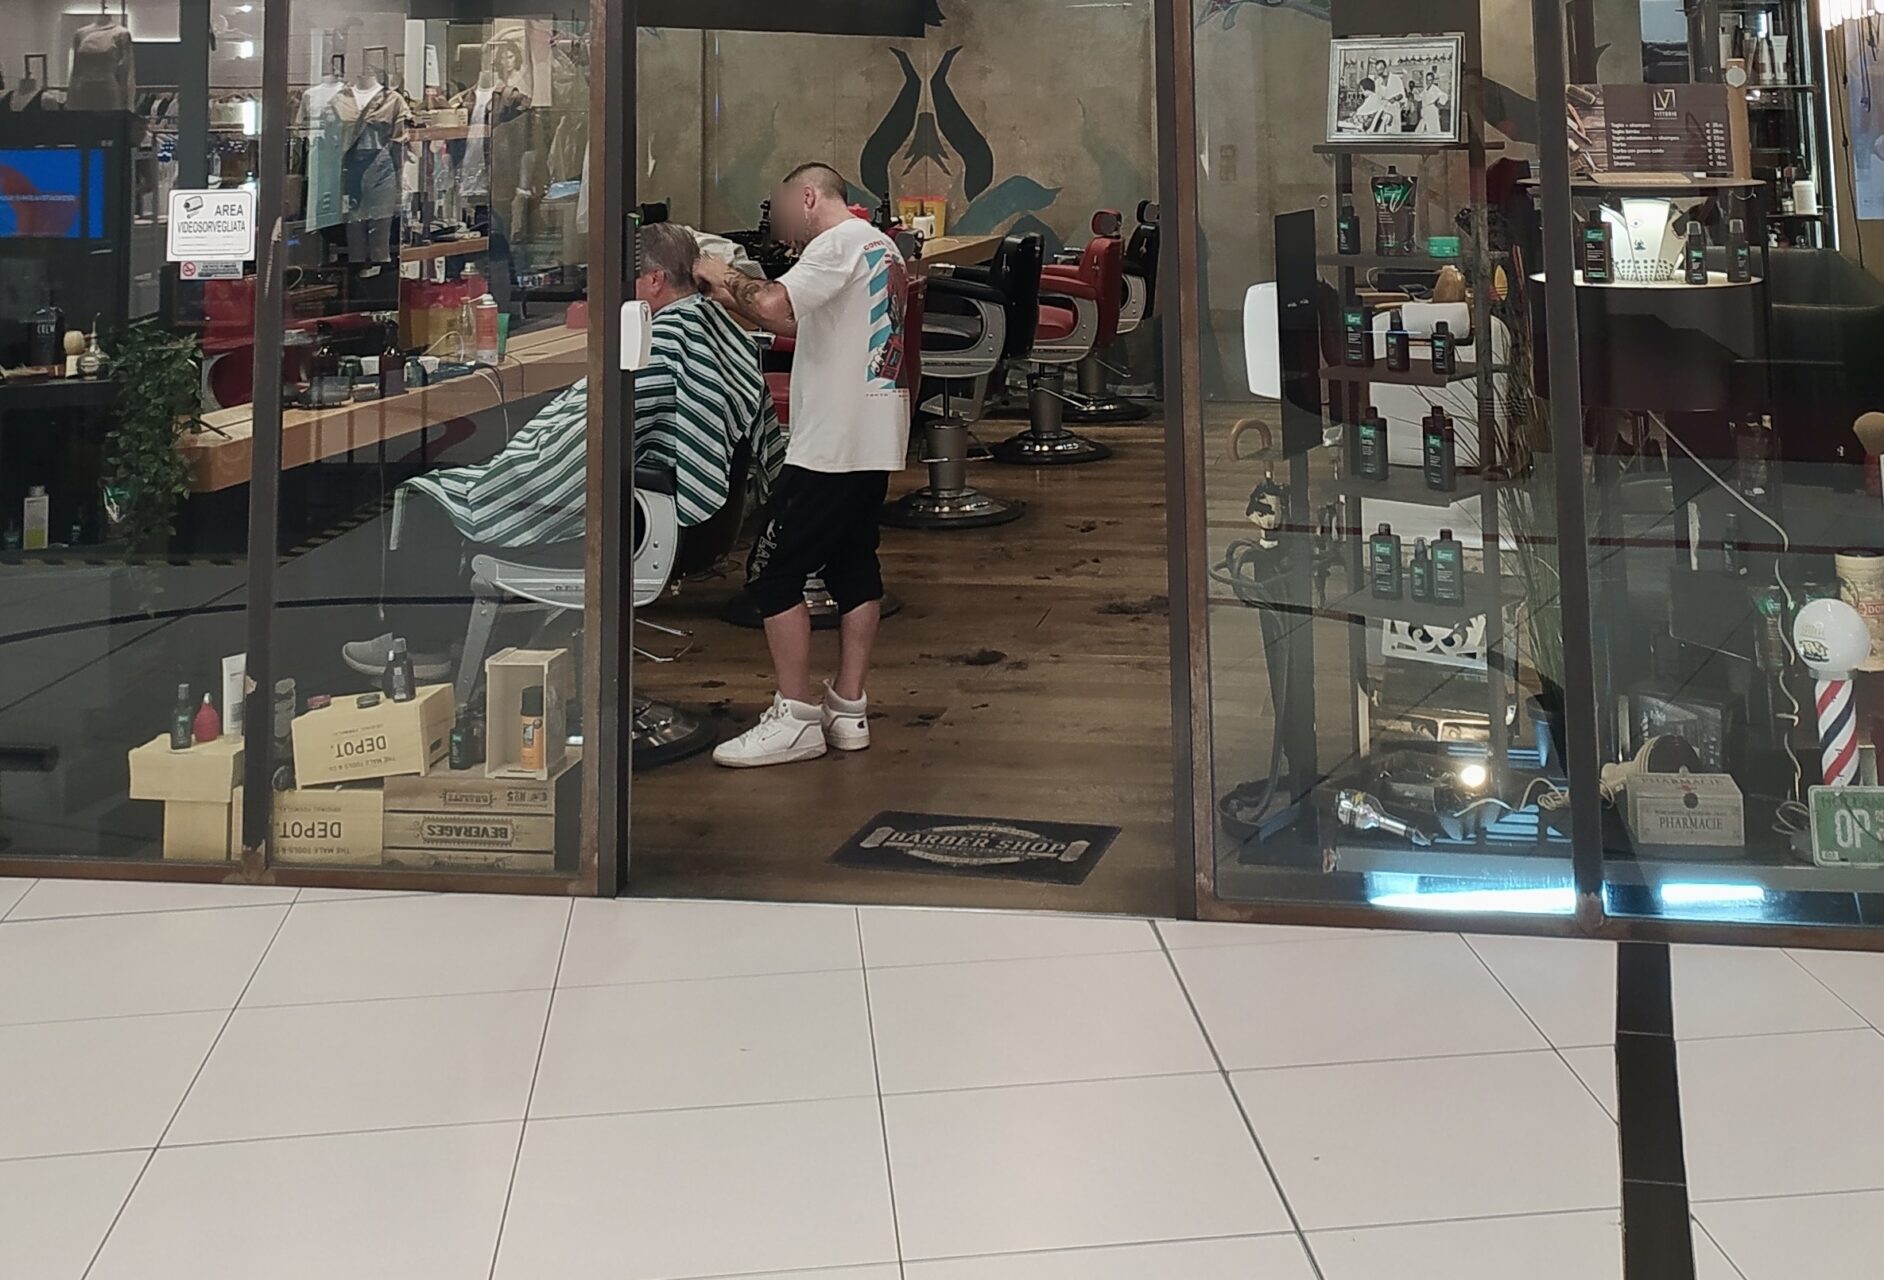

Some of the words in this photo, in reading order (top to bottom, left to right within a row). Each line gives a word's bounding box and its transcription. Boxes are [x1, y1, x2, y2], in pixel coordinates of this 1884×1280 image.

[214, 204, 244, 217] AREA
[177, 220, 246, 233] VIDEOSORVEGLIATA
[36, 324, 55, 335] CREW
[1659, 816, 1723, 830] PHARMACIE
[426, 824, 508, 839] BEVERAGES
[890, 831, 991, 849] BARBER
[998, 839, 1066, 854] SHOP
